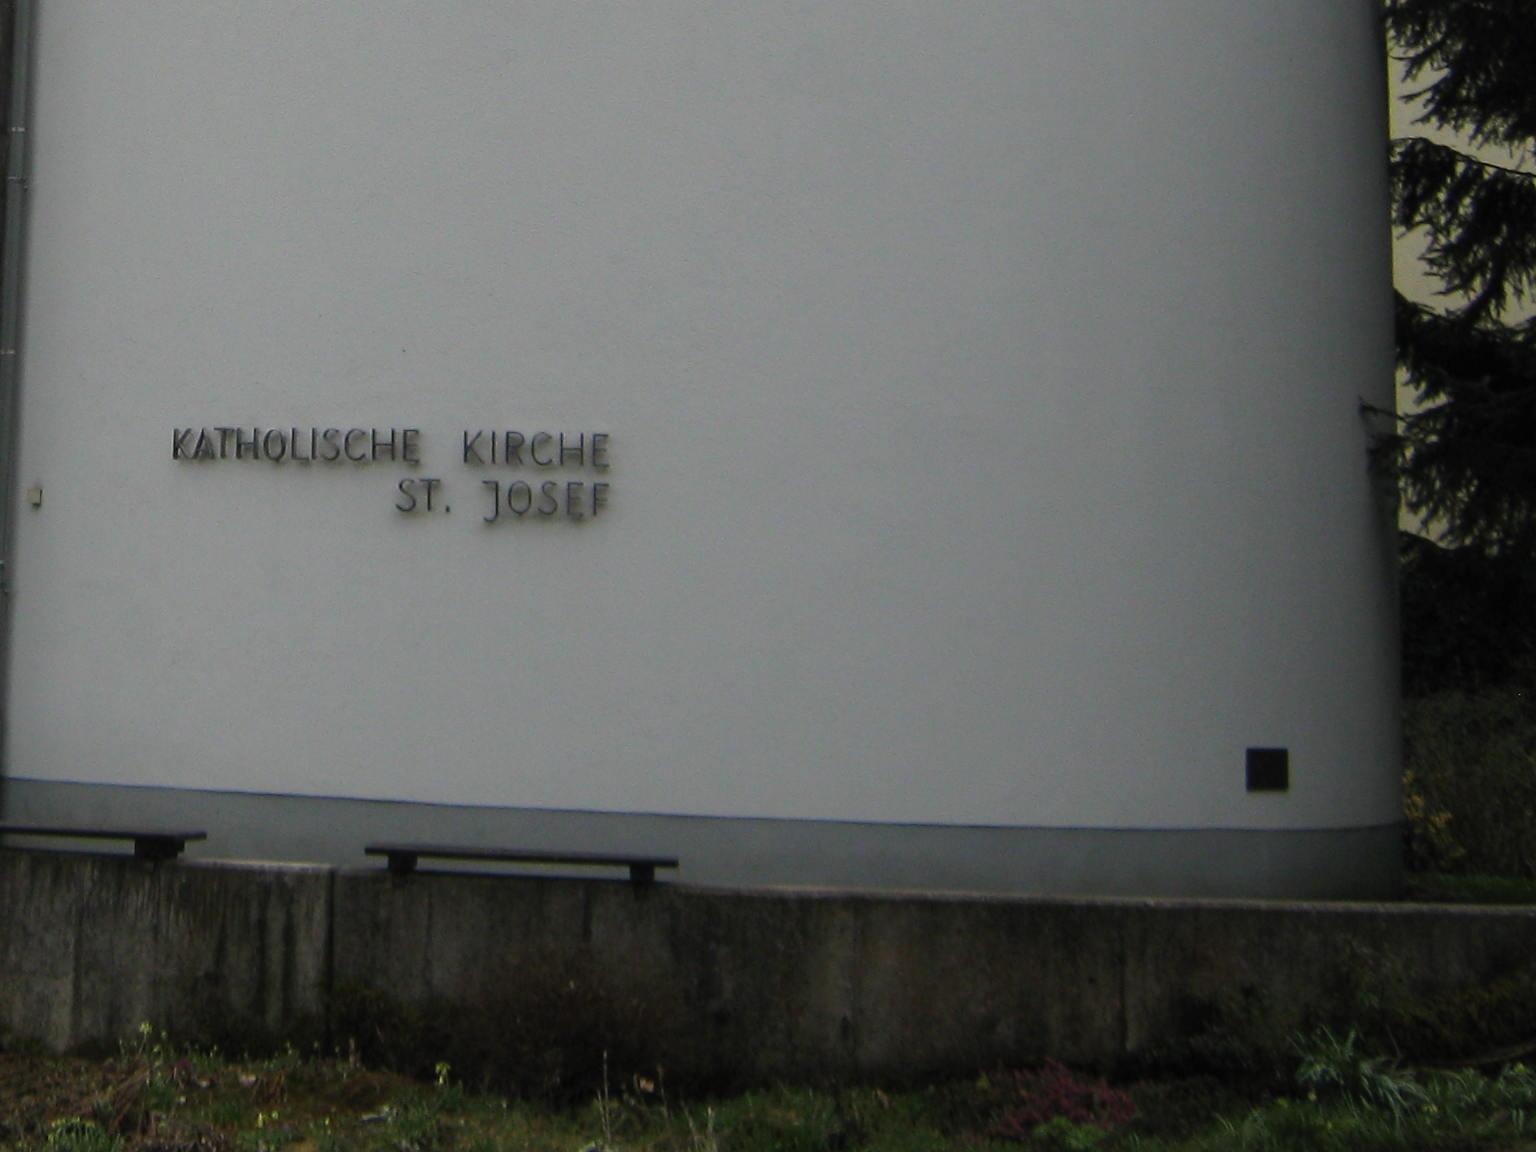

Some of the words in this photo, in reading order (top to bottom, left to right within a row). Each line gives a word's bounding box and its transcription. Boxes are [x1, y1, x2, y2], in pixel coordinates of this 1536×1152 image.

[172, 427, 421, 466] KATHOLISCHE
[463, 430, 612, 469] KIRCHE
[394, 478, 451, 514] ST.
[481, 480, 611, 523] JOSEF
